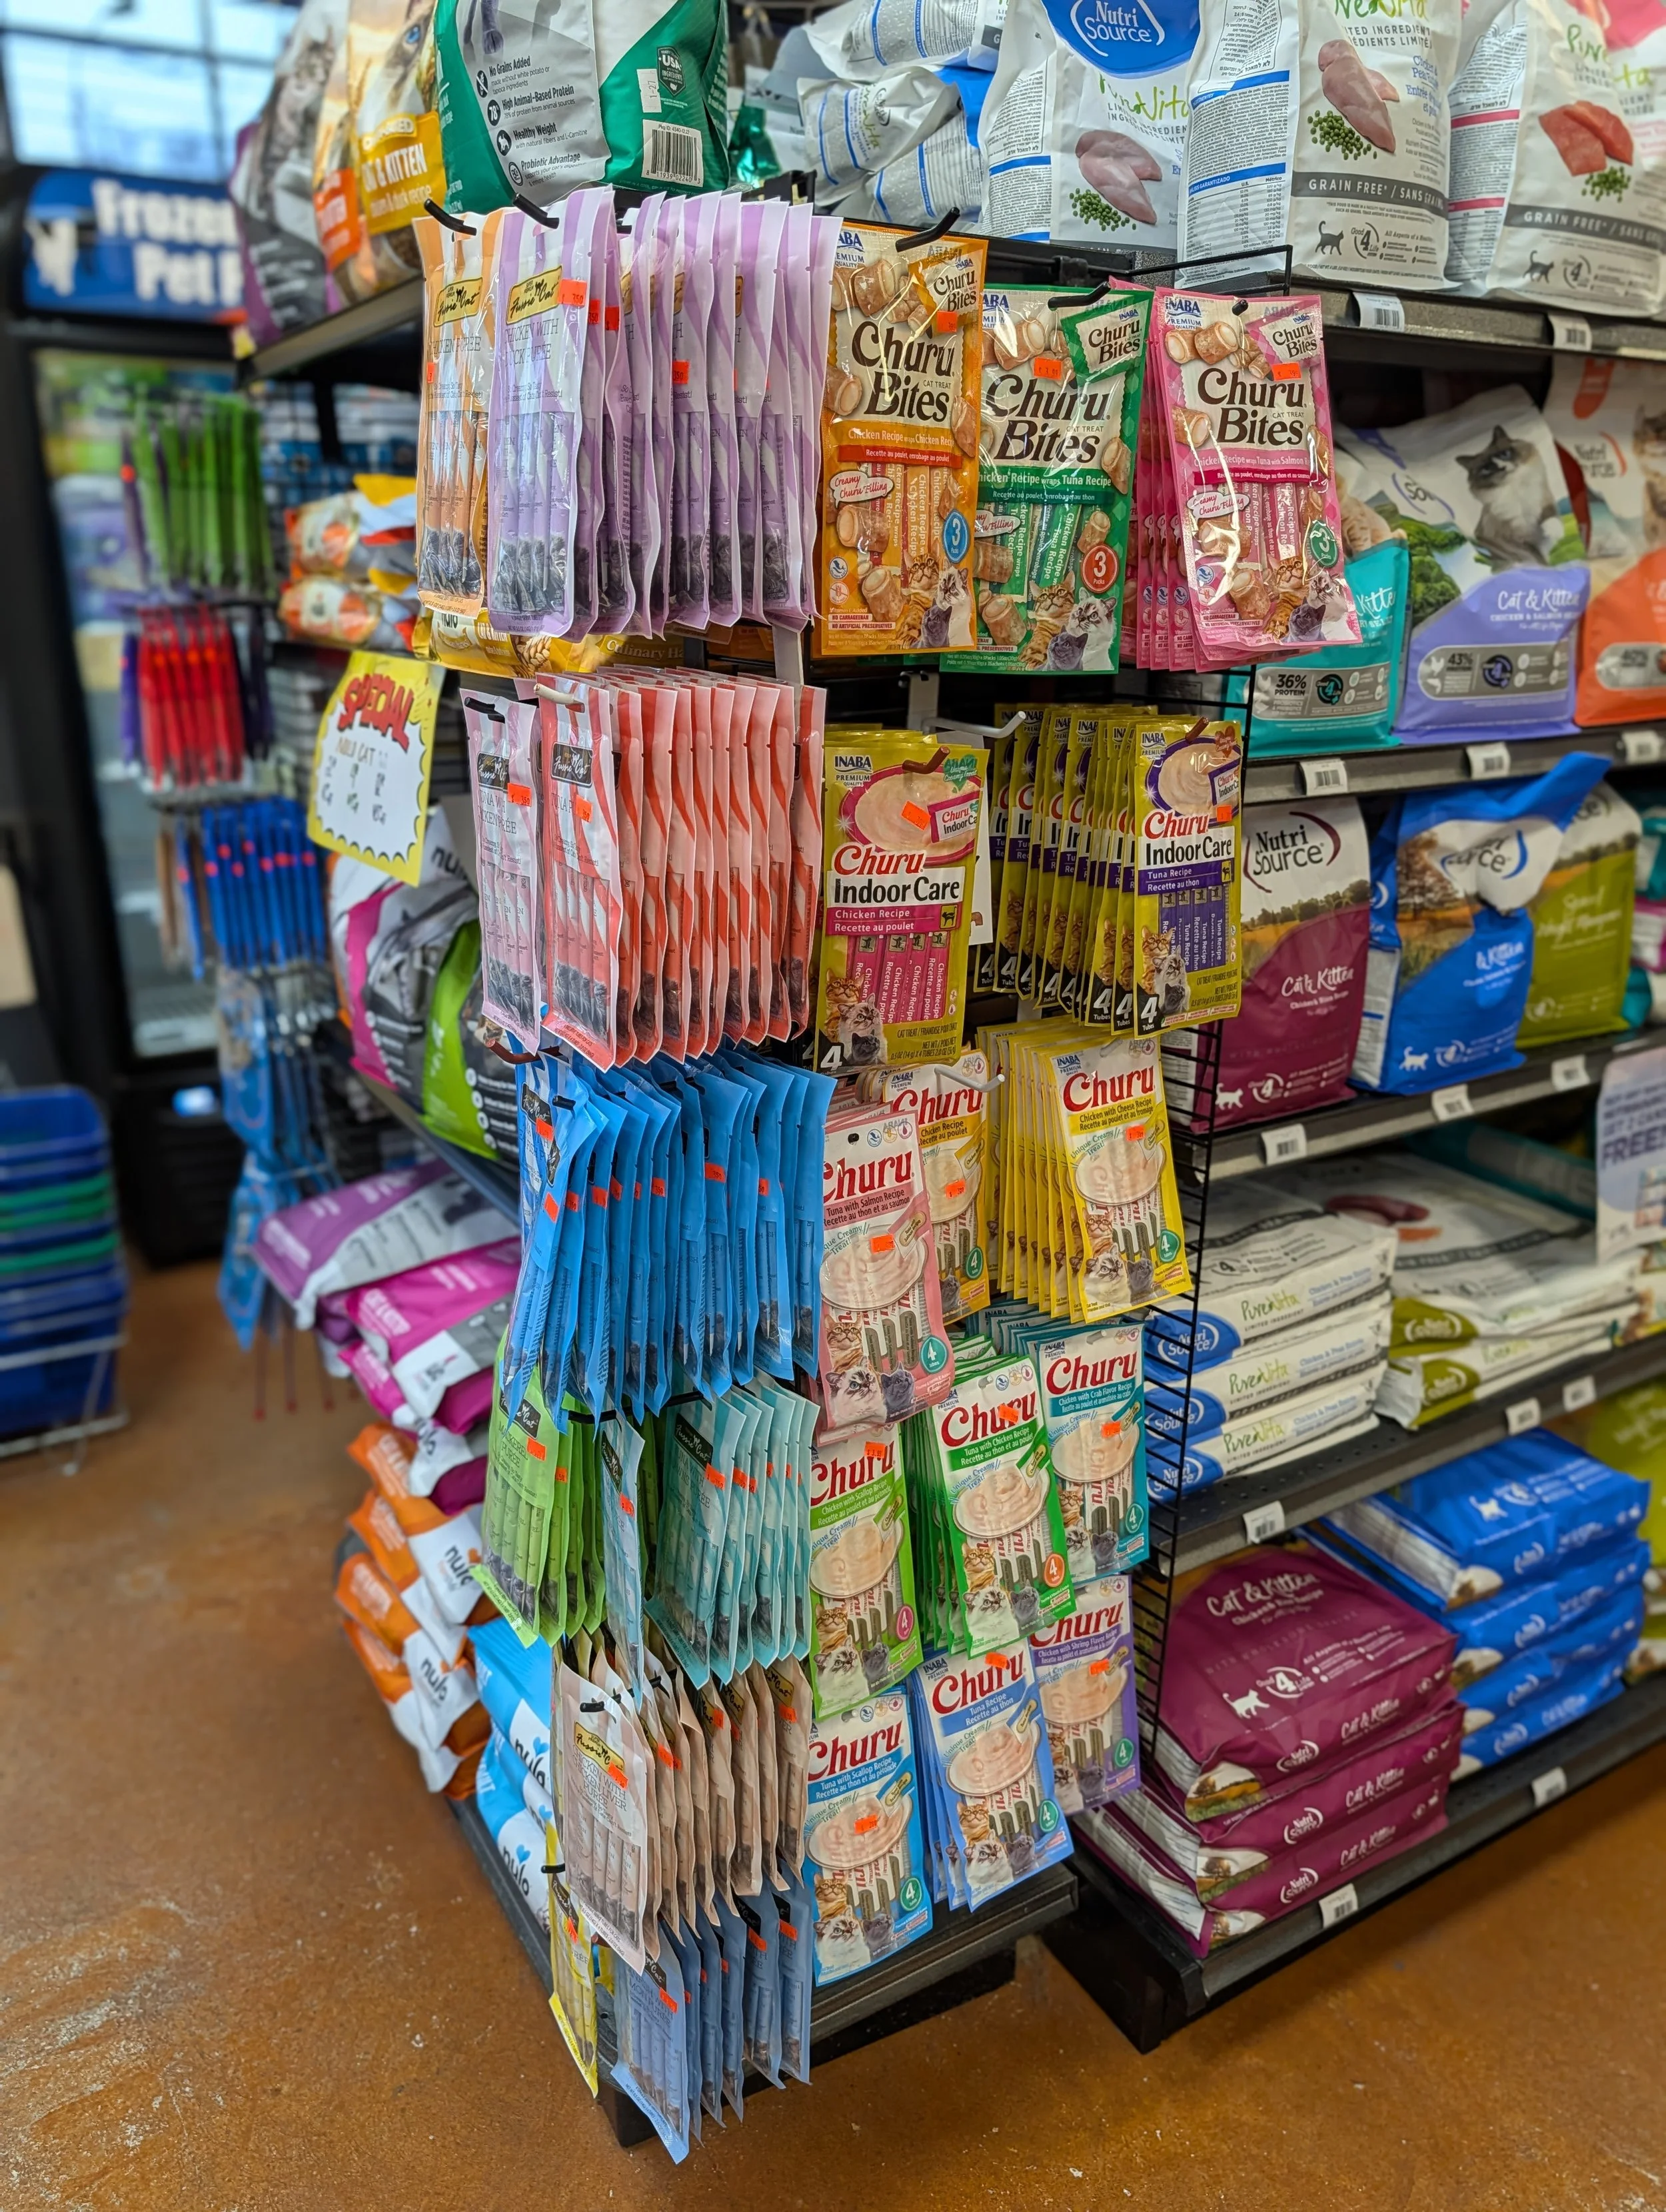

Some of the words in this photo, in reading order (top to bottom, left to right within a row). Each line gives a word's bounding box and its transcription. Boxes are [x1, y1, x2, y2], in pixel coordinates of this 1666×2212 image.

[1096, 1, 1138, 27] Nutri
[1084, 17, 1152, 42] Source
[489, 66, 496, 77] No
[497, 62, 512, 74] Grains
[513, 56, 530, 69] Added
[662, 55, 680, 69] USA
[506, 81, 528, 91] ingredients
[662, 70, 682, 81] INGREDIENTS
[502, 98, 513, 111] High
[514, 89, 552, 105] Animal-Based
[552, 85, 574, 97] Protein
[513, 127, 535, 141] Healthy
[536, 122, 557, 136] Weight
[565, 129, 587, 139] L-Carnitine
[521, 155, 548, 171] Probiotic
[548, 153, 580, 165] Advantage
[676, 174, 692, 183] 02240
[1200, 175, 1231, 189] GARANTIZADO
[1309, 179, 1351, 191] GRAIN
[1400, 187, 1422, 201] SANS
[1524, 211, 1568, 226] GRAIN
[1351, 227, 1364, 236] Good
[1360, 231, 1371, 251] 4
[934, 269, 976, 296] Churu
[510, 293, 534, 319] Fussie
[539, 282, 558, 298] Cat
[948, 289, 977, 312] Bites
[536, 318, 559, 336] WITH
[1088, 320, 1140, 349] Churu
[1272, 322, 1313, 346] Churu
[526, 341, 552, 361] PURÉE
[852, 321, 954, 377] Churu
[1099, 338, 1140, 364] Bites
[1286, 338, 1317, 358] Bites
[864, 370, 950, 422] Bites
[986, 374, 1106, 421] Churu
[1198, 368, 1305, 408] Churu
[1216, 407, 1303, 446] Bites
[916, 435, 939, 446] Chicken
[994, 420, 1100, 463] Bites
[1256, 456, 1271, 465] Tuna
[1281, 456, 1302, 465] Salmon
[834, 474, 861, 488] Creamy
[1062, 474, 1083, 485] Tuna
[1086, 475, 1112, 487] Recipe
[1094, 550, 1106, 578] 3
[1497, 590, 1523, 611] Cat
[1525, 589, 1541, 611] &
[1541, 588, 1580, 612] Kitten
[606, 639, 665, 660] Culinary
[1448, 653, 1473, 666] 43%
[1276, 674, 1307, 689] 36%
[338, 673, 415, 754] SPECIAL
[1142, 732, 1165, 744] INABA
[835, 755, 872, 768] INABA
[942, 806, 970, 824] Churu
[1144, 811, 1208, 839] Churu
[1256, 824, 1309, 853] Nutri
[834, 845, 924, 875] Churu
[1253, 845, 1323, 875] Source
[1148, 871, 1168, 879] Tuna
[1170, 867, 1192, 877] Recipe
[1148, 882, 1176, 891] Recette
[835, 909, 876, 919] Chicken
[879, 909, 910, 919] Recipe
[835, 923, 871, 931] Recette
[886, 922, 914, 933] poulet
[1281, 977, 1304, 997] Cat
[1317, 966, 1354, 991] Kitten
[1093, 988, 1112, 1014] 4
[1141, 997, 1158, 1023] 4
[820, 1045, 843, 1071] 4
[1063, 1065, 1154, 1112] Churu
[893, 1087, 982, 1125] Churu
[1080, 1112, 1104, 1123] Chicken
[1117, 1103, 1134, 1114] Cheese
[1135, 1098, 1152, 1109] Recipe
[921, 1124, 941, 1137] Chicken
[942, 1120, 964, 1131] Recipe
[947, 1127, 968, 1139] poulet
[1080, 1122, 1101, 1131] Recette
[1108, 1116, 1123, 1125] poulet
[823, 1151, 912, 1203] Churu
[826, 1204, 843, 1217] Tuna
[844, 1201, 860, 1213] with
[860, 1195, 883, 1209] Salmon
[884, 1189, 905, 1204] Recipe
[858, 1208, 873, 1219] thon
[889, 1197, 910, 1210] saumon
[837, 1225, 863, 1240] Creamy
[1162, 1235, 1170, 1252] 4
[830, 1237, 852, 1255] Treat!
[1046, 1351, 1137, 1395] Churu
[941, 1390, 1036, 1447] Churu
[964, 1445, 979, 1456] Tuna
[979, 1438, 992, 1451] with
[992, 1434, 1013, 1446] Chicken
[1014, 1426, 1030, 1438] Recipe
[961, 1454, 984, 1466] Recette
[992, 1445, 1005, 1455] thon
[822, 1502, 844, 1515] Chicken
[856, 1488, 873, 1501] Scallop
[818, 1513, 838, 1526] Recette
[1207, 1588, 1243, 1617] Cat
[1244, 1582, 1262, 1602] &
[1260, 1572, 1320, 1600] Kitten
[932, 1650, 1024, 1714] Churu
[1274, 1671, 1297, 1694] 4
[965, 1710, 990, 1726] Recette
[1000, 1697, 1014, 1710] thon
[970, 1704, 986, 1716] Tuna
[986, 1692, 1007, 1708] Recipe
[808, 1720, 902, 1782] Churu
[821, 1780, 836, 1790] Tuna
[837, 1774, 852, 1785] with
[852, 1768, 873, 1780] Scallop
[874, 1757, 892, 1770] Recipe
[602, 1786, 627, 1812] LIVER
[604, 1776, 626, 1800] WITH
[816, 1788, 839, 1799] Recette
[847, 1780, 861, 1790] thon
[805, 1808, 827, 1827] Unique
[828, 1794, 852, 1810] Creamy
